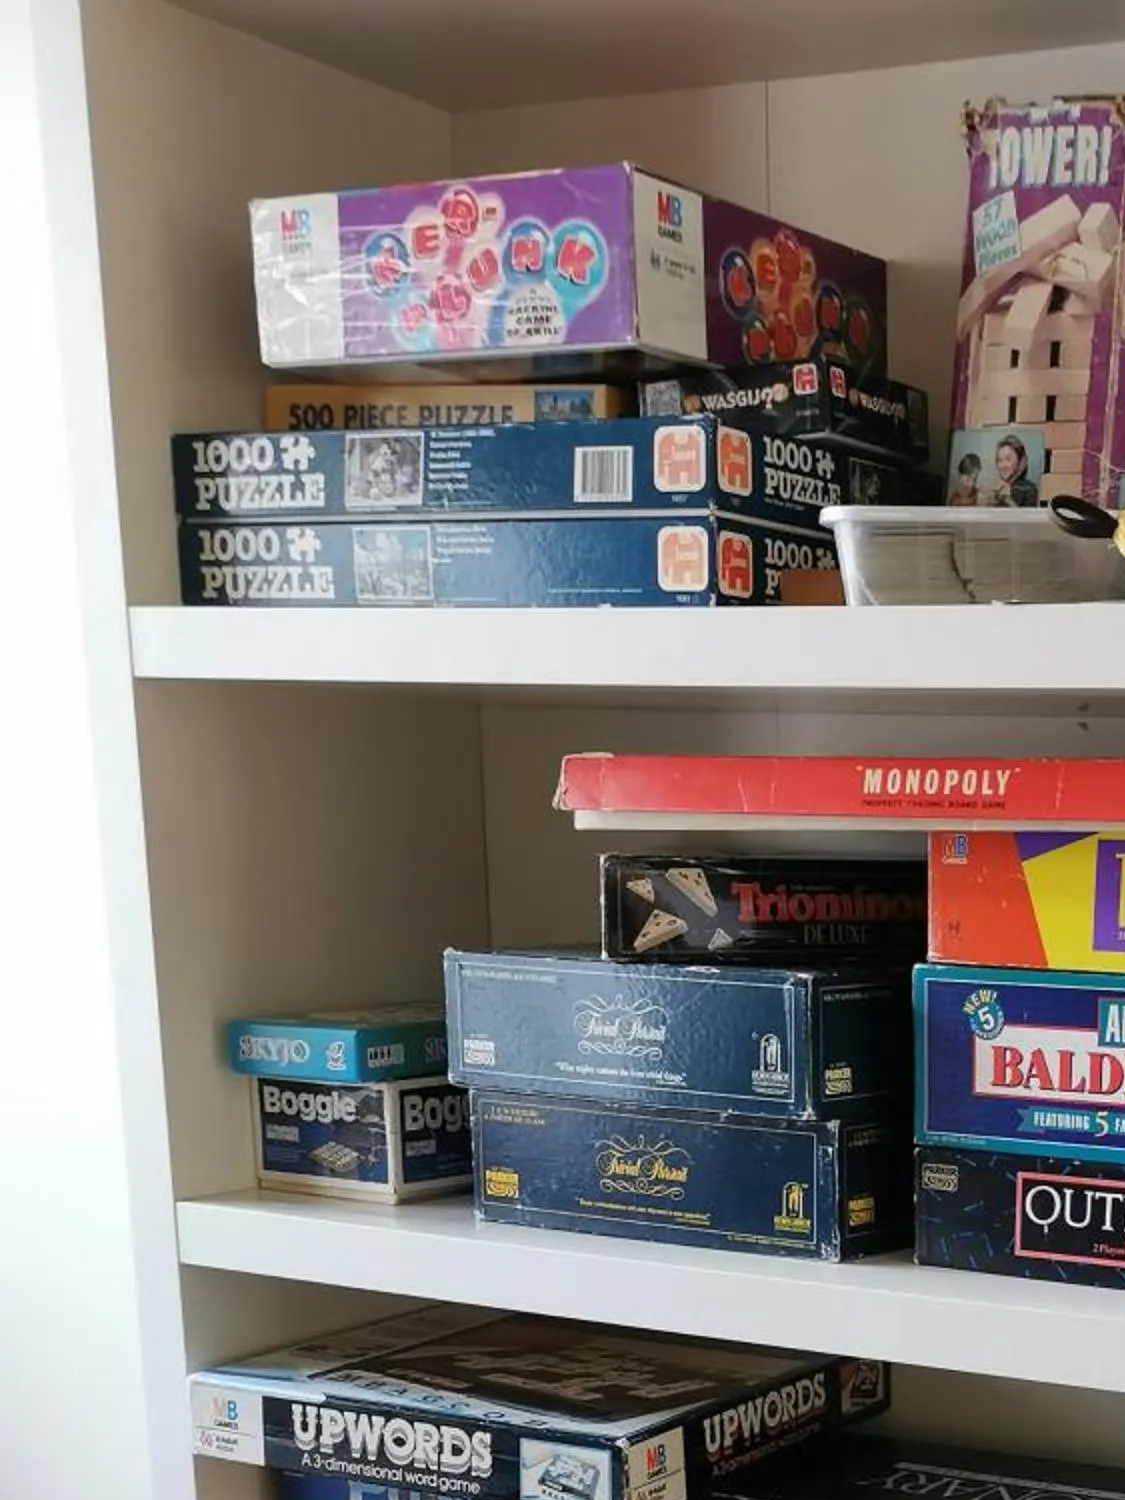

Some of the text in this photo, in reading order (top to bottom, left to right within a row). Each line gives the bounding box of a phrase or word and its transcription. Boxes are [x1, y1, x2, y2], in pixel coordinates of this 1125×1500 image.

[657, 191, 683, 226] MB
[289, 402, 514, 429] 500 PIECE PUZZLE
[193, 437, 275, 472] 1000
[763, 435, 813, 472] 1000
[195, 472, 326, 510] PUZZLE
[764, 467, 842, 507] PUZZLE
[198, 529, 281, 563] 1000
[764, 538, 813, 569] 1000
[201, 565, 335, 601] PUZZLE
[863, 767, 1012, 796] MONOPOLY
[803, 923, 869, 945] DELUXE
[977, 1005, 995, 1031] 5
[262, 1084, 358, 1125] Boggle
[402, 1094, 471, 1134] Bog
[1033, 1110, 1090, 1131] FEATURING
[1094, 1110, 1109, 1138] 5
[1092, 1242, 1099, 1254] 2
[703, 1372, 827, 1459] UPWORDS
[291, 1403, 493, 1478] UPWORDS
[300, 1453, 481, 1495] A 3-dimensional word game
